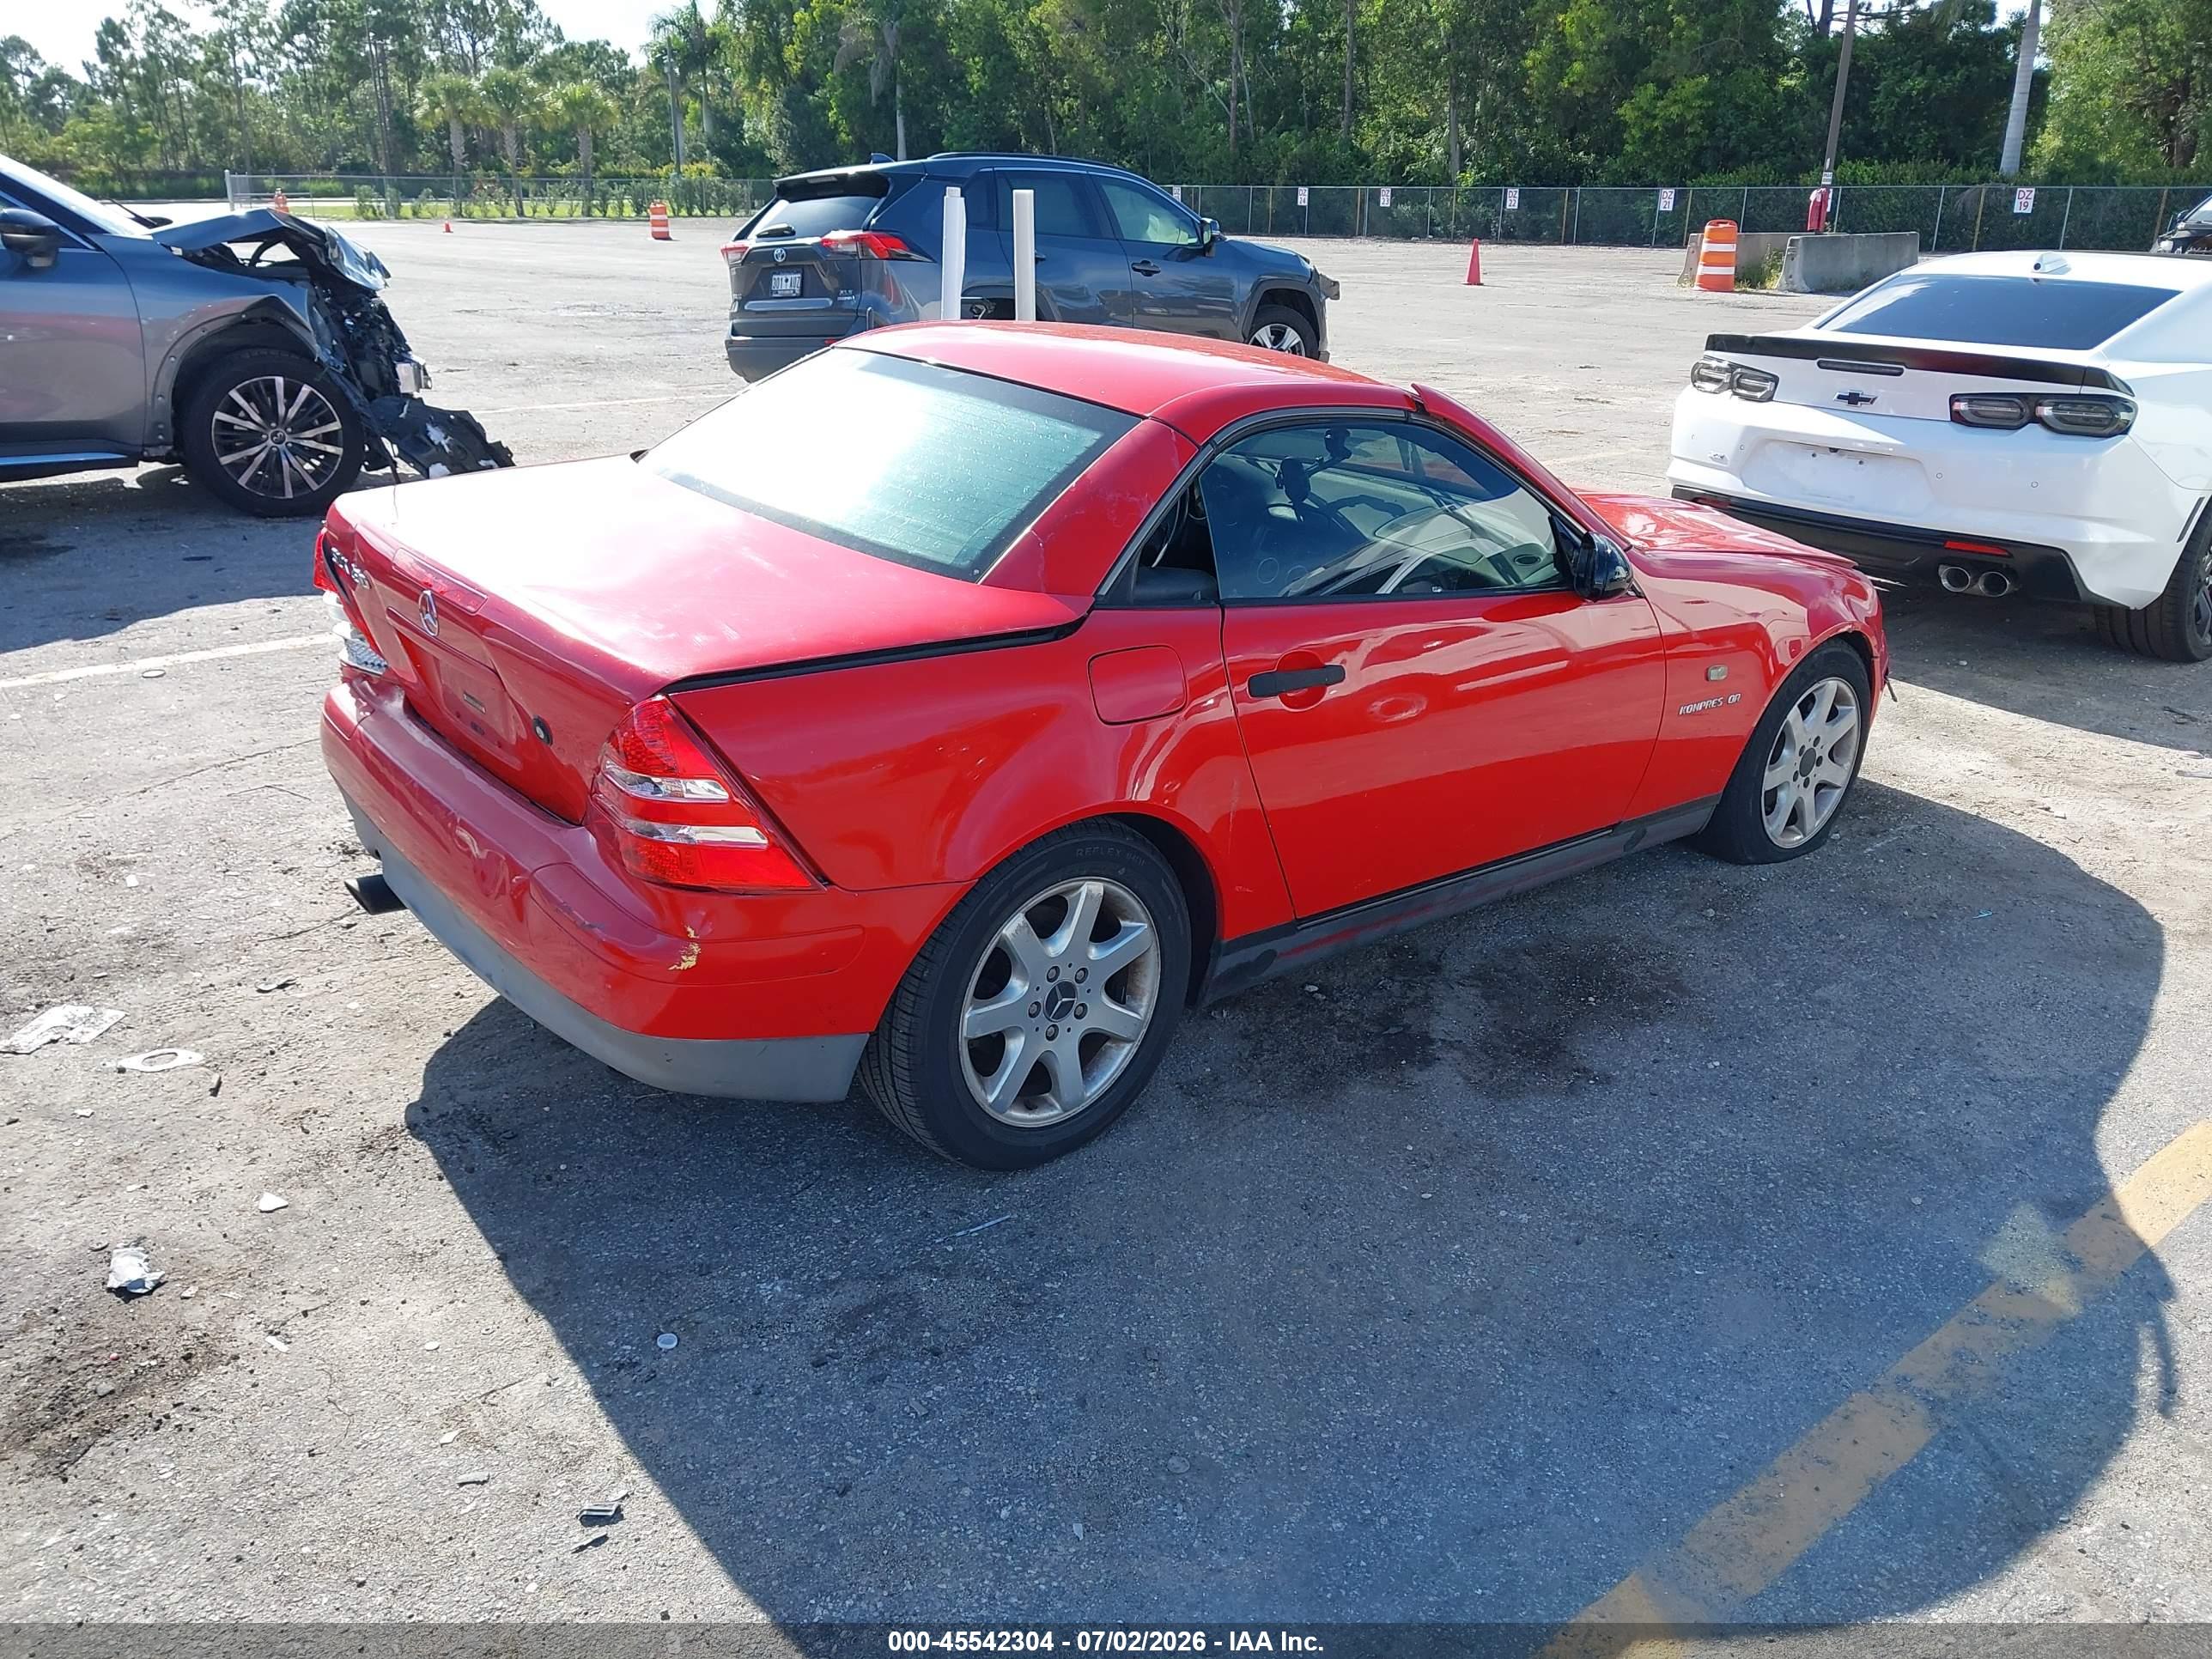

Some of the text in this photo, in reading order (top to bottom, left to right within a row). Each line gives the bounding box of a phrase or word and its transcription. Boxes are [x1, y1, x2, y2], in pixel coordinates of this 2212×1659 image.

[1381, 189, 1390, 198] DZ
[1508, 190, 1518, 198] DZ
[1662, 191, 1674, 199] DZ
[2017, 190, 2033, 200] DZ
[1508, 198, 1516, 207] 22
[1662, 200, 1670, 209] 21
[2019, 201, 2029, 211] 19
[1679, 697, 1724, 715] KOMPRES
